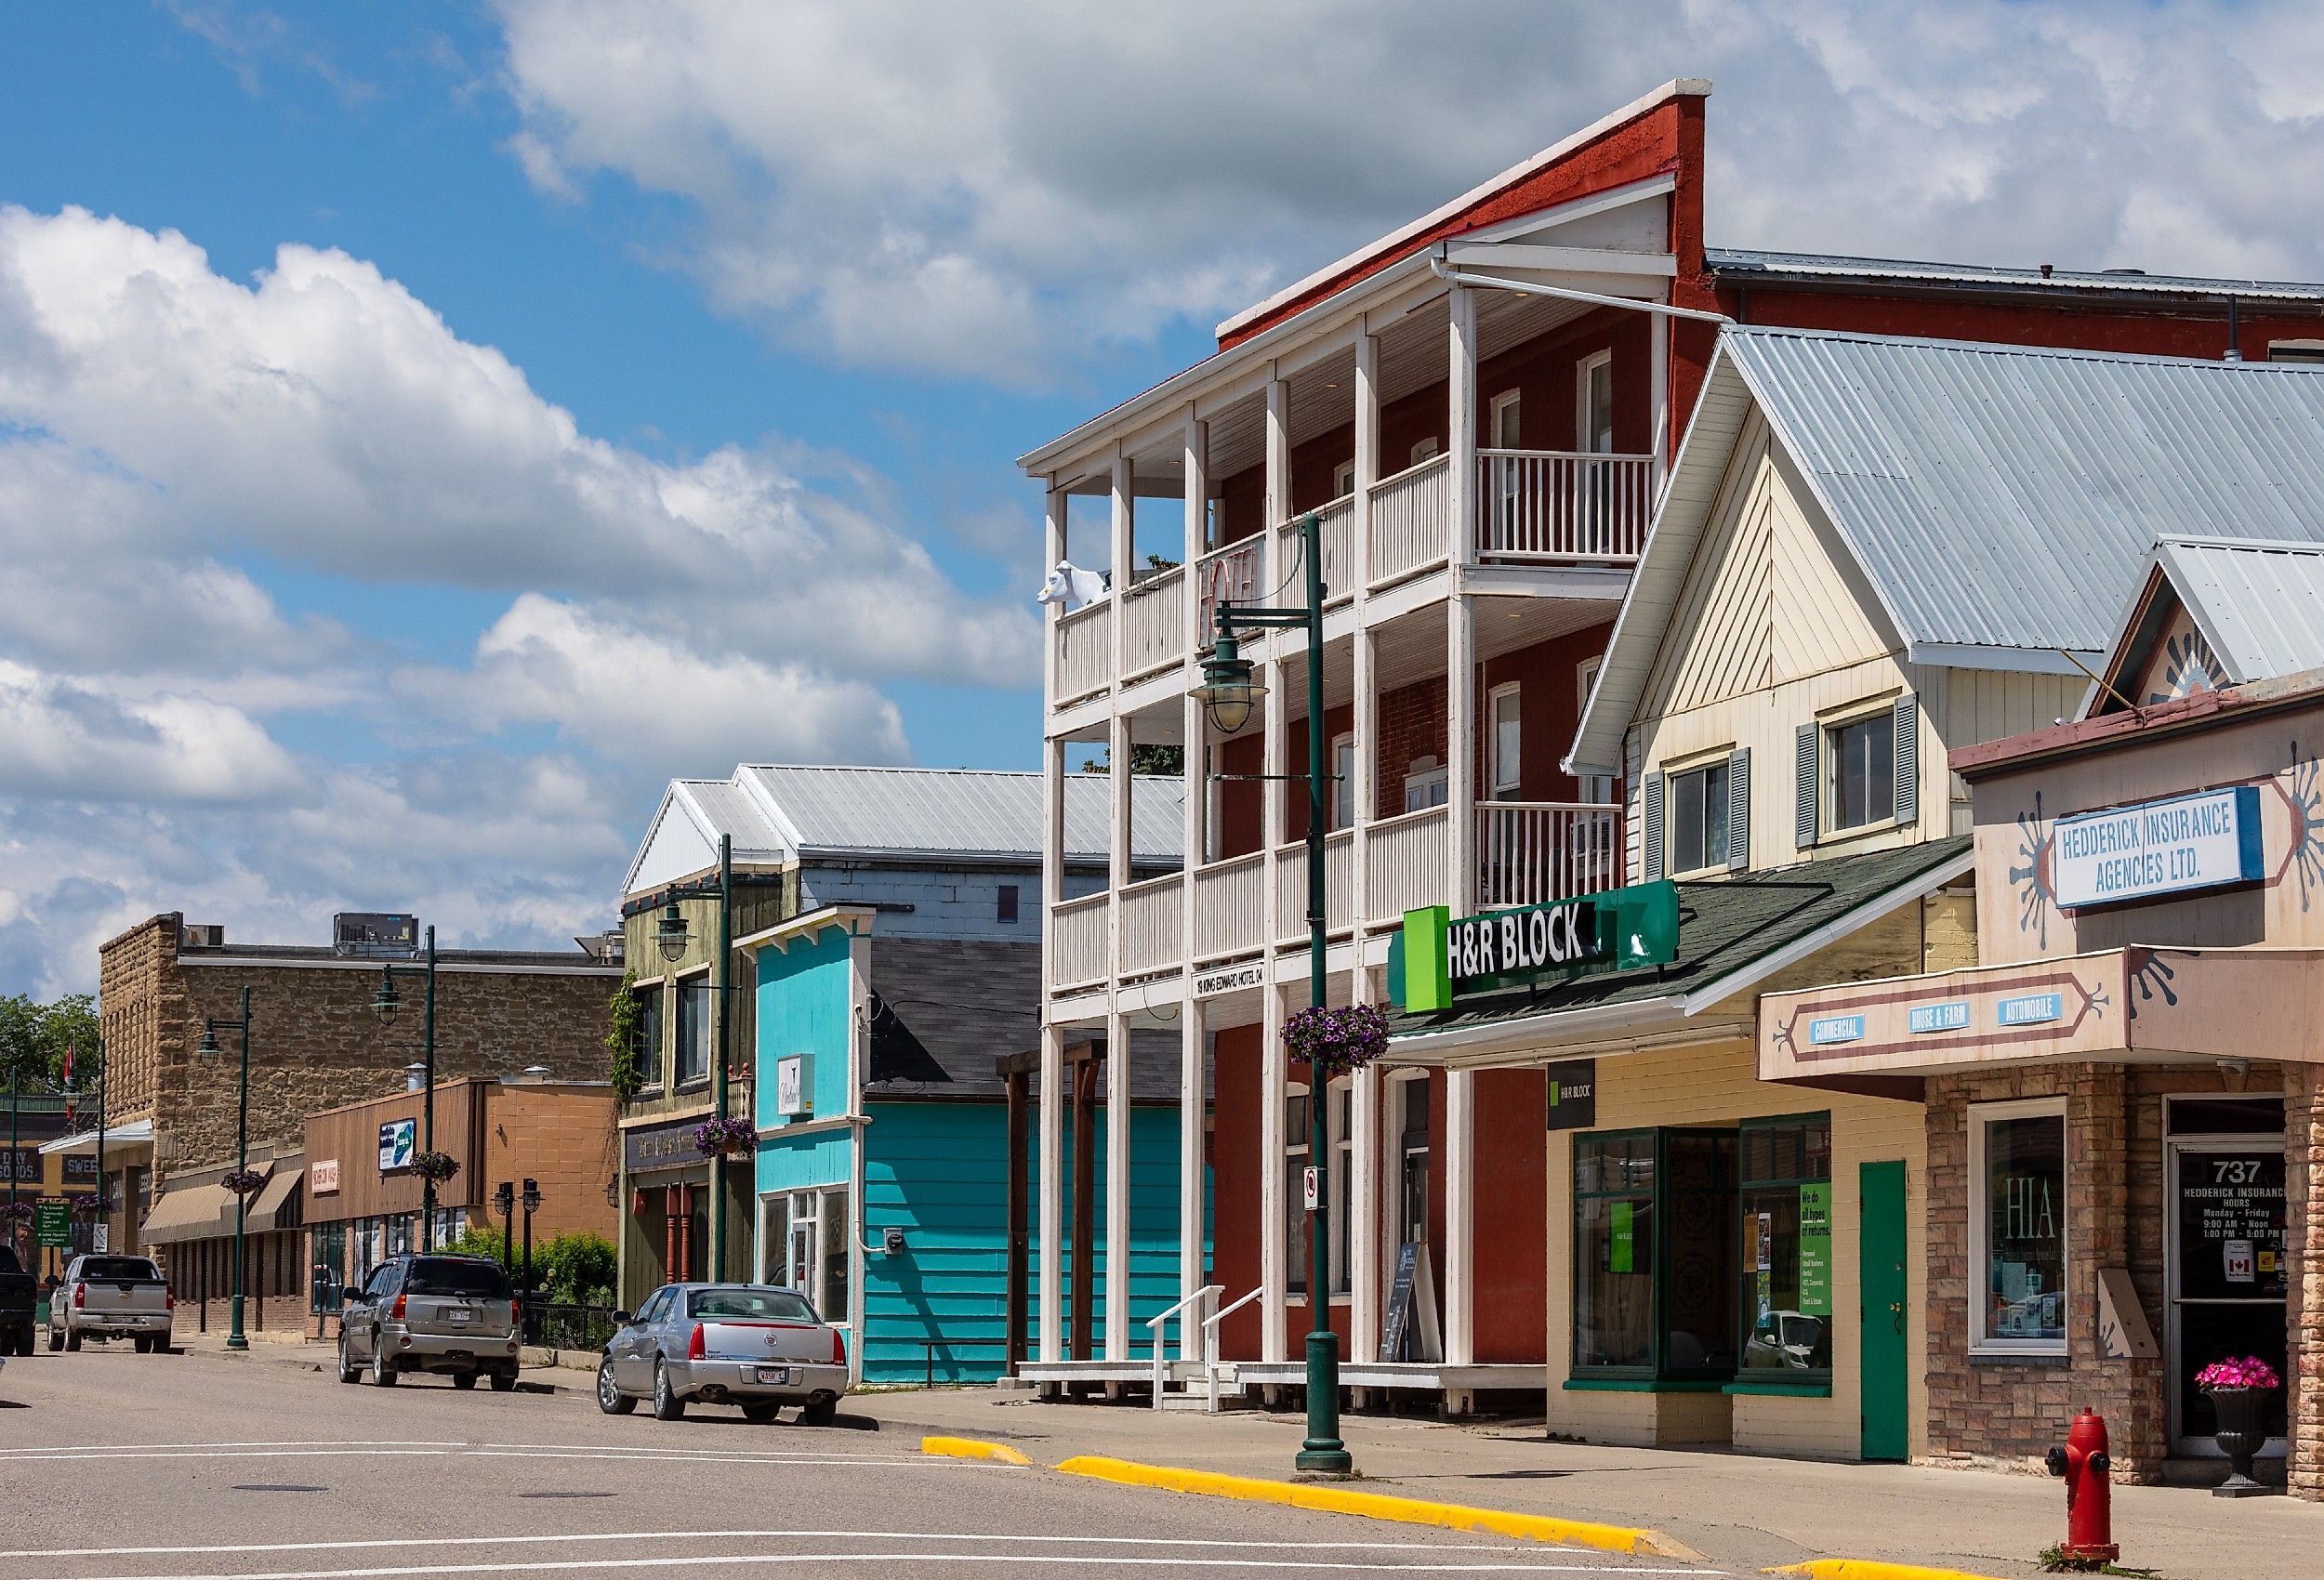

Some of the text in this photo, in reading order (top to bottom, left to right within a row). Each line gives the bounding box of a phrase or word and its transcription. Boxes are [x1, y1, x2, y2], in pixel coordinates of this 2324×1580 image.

[2063, 801, 2231, 860] HEDDERICK INSURANCE
[2095, 847, 2200, 893] AGENCIES LTD.
[1446, 902, 1584, 979] H&R BLOCK
[1203, 977, 1215, 993] KING
[1216, 973, 1237, 991] EDWARD
[1238, 969, 1255, 986] HOTEL
[1911, 1004, 1965, 1029] HOUSE & FARM
[2005, 997, 2053, 1021] AUTOMOBILE
[1815, 1018, 1858, 1041] COMMERCIAL
[1561, 1085, 1591, 1099] H&R BLOCK
[67, 1158, 98, 1173] SWEE
[2212, 1160, 2262, 1184] 737
[1802, 1190, 1819, 1204] We do
[2184, 1188, 2287, 1198] HEDDERICK INSURANC
[2005, 1177, 2056, 1239] HIA
[2223, 1199, 2251, 1207] HOURS
[1810, 1207, 1825, 1223] types
[2203, 1208, 2234, 1218] Monday
[2245, 1208, 2270, 1218] Friday
[2203, 1219, 2222, 1228] 9:00
[2225, 1219, 2238, 1228] AM
[2248, 1219, 2268, 1228] Noon
[2203, 1230, 2220, 1238] 1:00
[2223, 1230, 2235, 1238] PM
[2246, 1230, 2265, 1238] 5:00
[2268, 1230, 2279, 1238] PM
